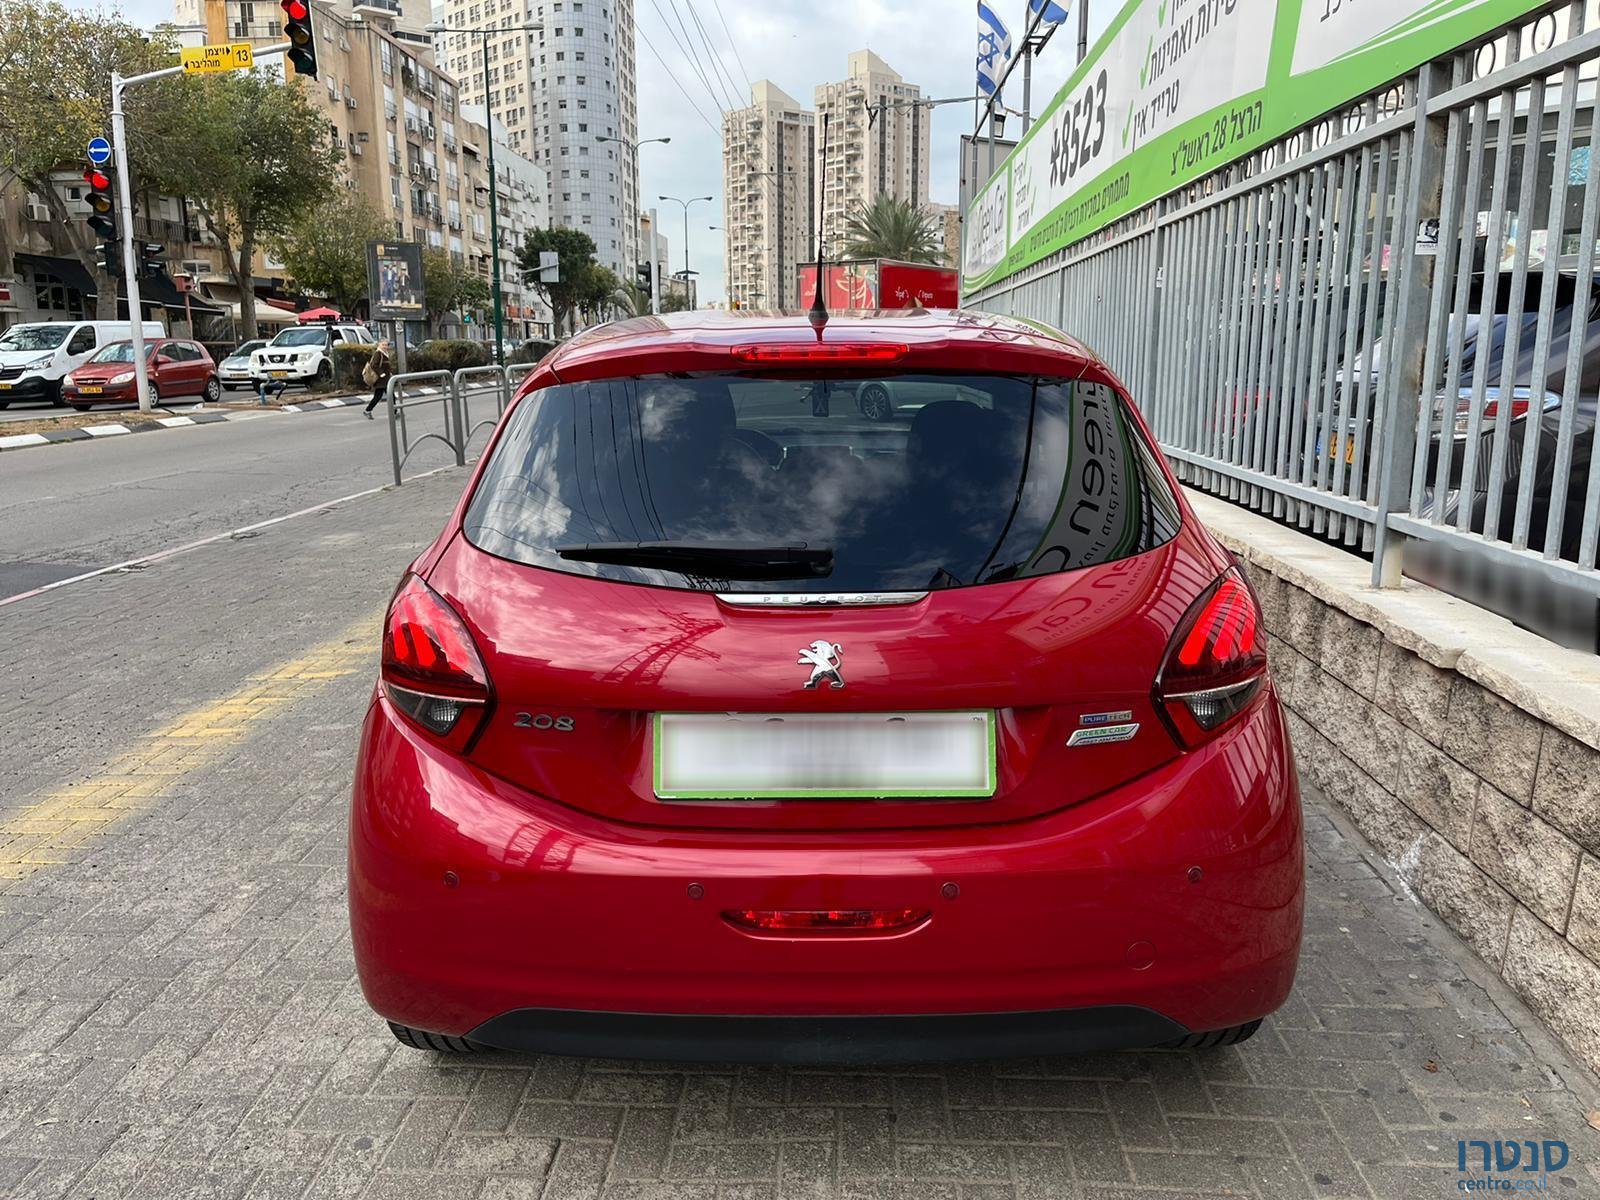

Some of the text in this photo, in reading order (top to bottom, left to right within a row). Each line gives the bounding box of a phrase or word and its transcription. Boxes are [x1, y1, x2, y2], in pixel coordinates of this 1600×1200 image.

[204, 46, 225, 59] ויצמן
[235, 49, 249, 62] 13
[1148, 15, 1193, 86] ואמינות
[190, 58, 221, 69] מוהליבר
[1132, 78, 1180, 153] טרייד אין
[1171, 100, 1263, 176] הרצל 28 ראשל"צ
[763, 595, 882, 603] PEUGEOT
[513, 711, 574, 732] 208
